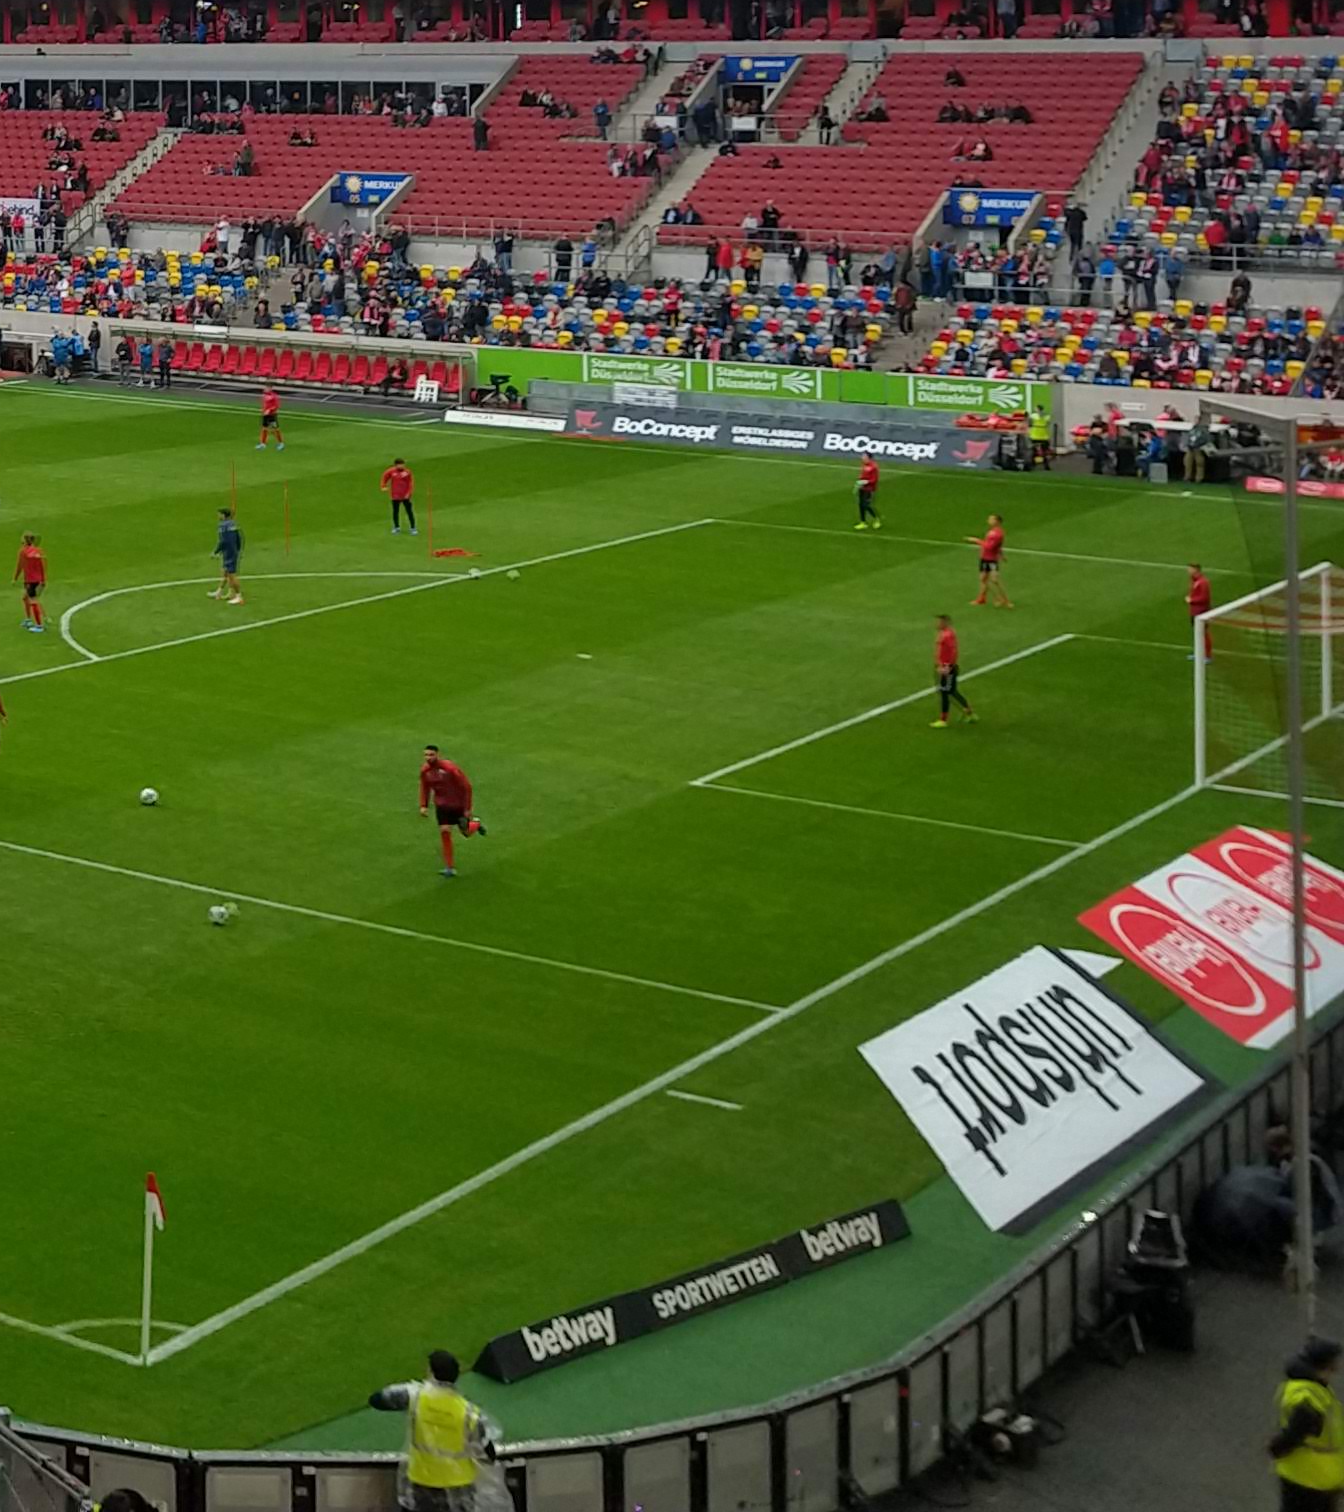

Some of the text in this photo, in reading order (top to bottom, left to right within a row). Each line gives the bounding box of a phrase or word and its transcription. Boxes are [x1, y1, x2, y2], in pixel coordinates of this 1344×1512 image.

[590, 358, 650, 371] Stadtwerke
[716, 366, 778, 381] Stadtwerke
[716, 376, 778, 392] Düsseldorf
[917, 379, 983, 394] Stadtwerke
[917, 391, 984, 406] Düsseldorf
[613, 417, 719, 443] BoConcept
[823, 433, 939, 461] BoConcept
[912, 985, 1143, 1178] uhlsport
[520, 1210, 883, 1363] betway SPORTWETTEN betway
